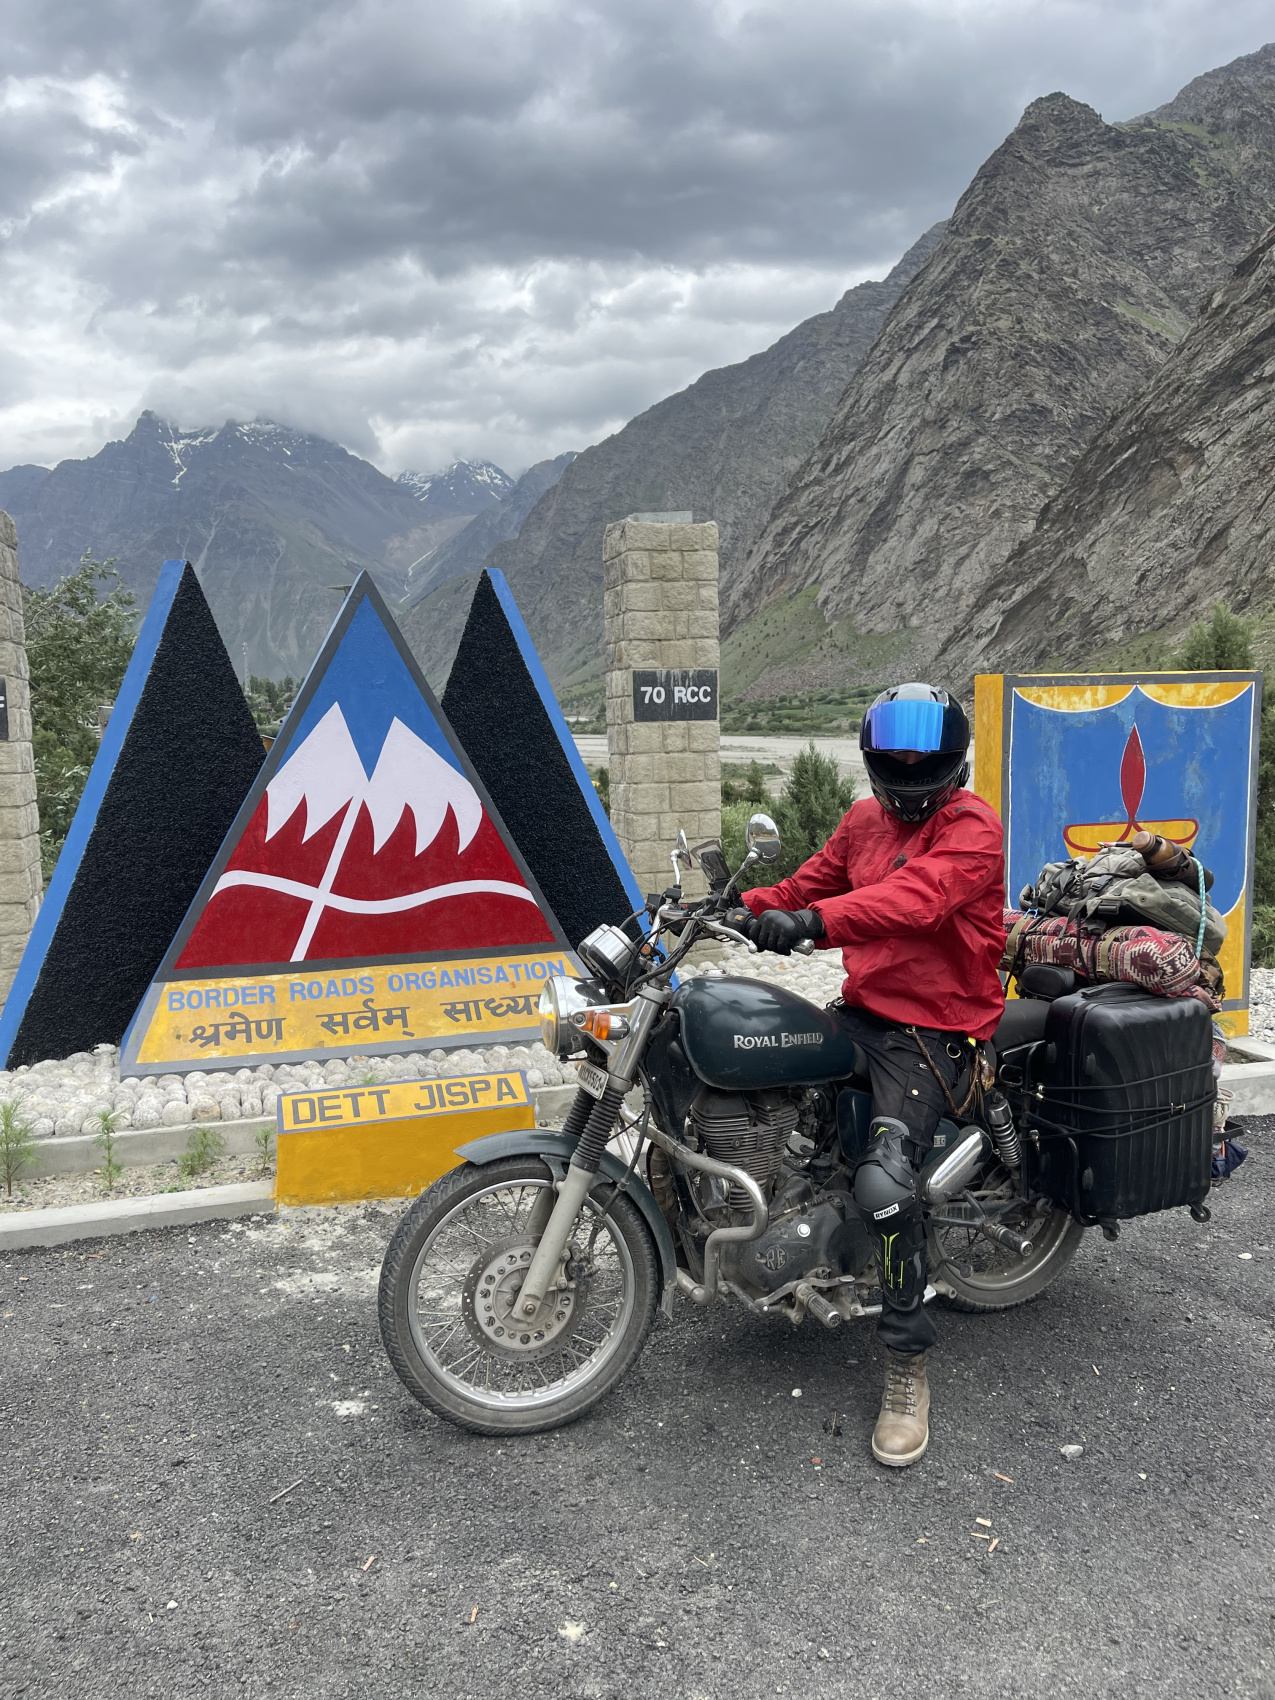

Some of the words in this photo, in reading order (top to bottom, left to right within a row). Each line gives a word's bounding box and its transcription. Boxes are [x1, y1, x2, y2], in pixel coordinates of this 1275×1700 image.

[640, 686, 666, 704] 70
[673, 685, 712, 704] RCC
[168, 984, 276, 1012] BORDER
[289, 976, 375, 1002] ROADS
[387, 959, 566, 993] ORGANISATION
[189, 1011, 287, 1049] श्रमेण
[315, 998, 416, 1038] सर्वम्
[733, 1034, 779, 1050] ROYAL
[780, 1031, 824, 1048] ENFIELD
[291, 1089, 391, 1125] DETT
[413, 1077, 518, 1111] JISPA
